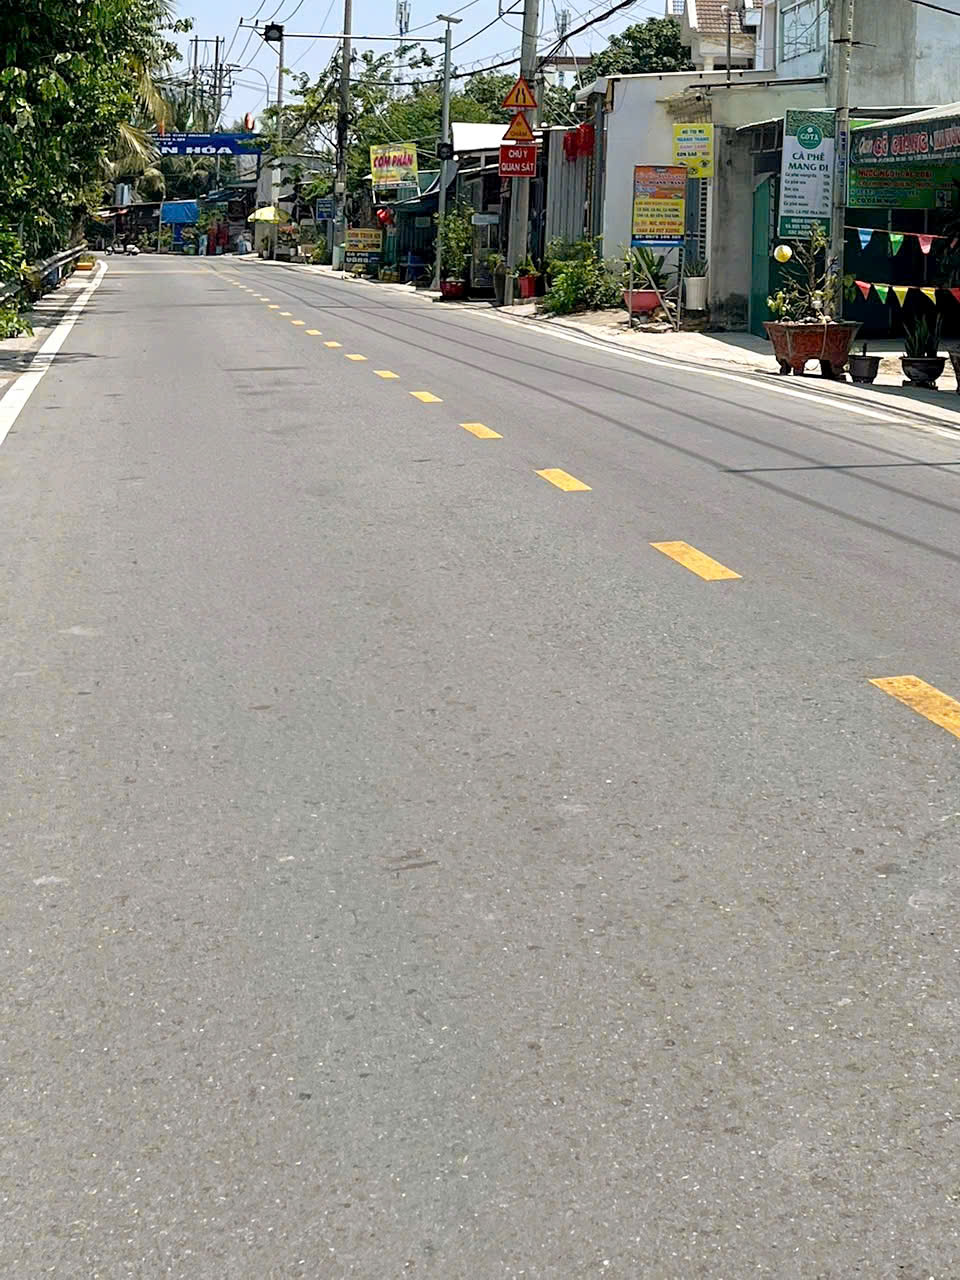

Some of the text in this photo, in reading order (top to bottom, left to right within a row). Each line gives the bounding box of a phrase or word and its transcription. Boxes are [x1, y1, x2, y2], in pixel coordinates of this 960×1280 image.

[800, 133, 819, 141] GOTA
[891, 132, 929, 155] GIANG
[501, 161, 534, 172] QUAN SÁT
[788, 162, 817, 171] MANG
